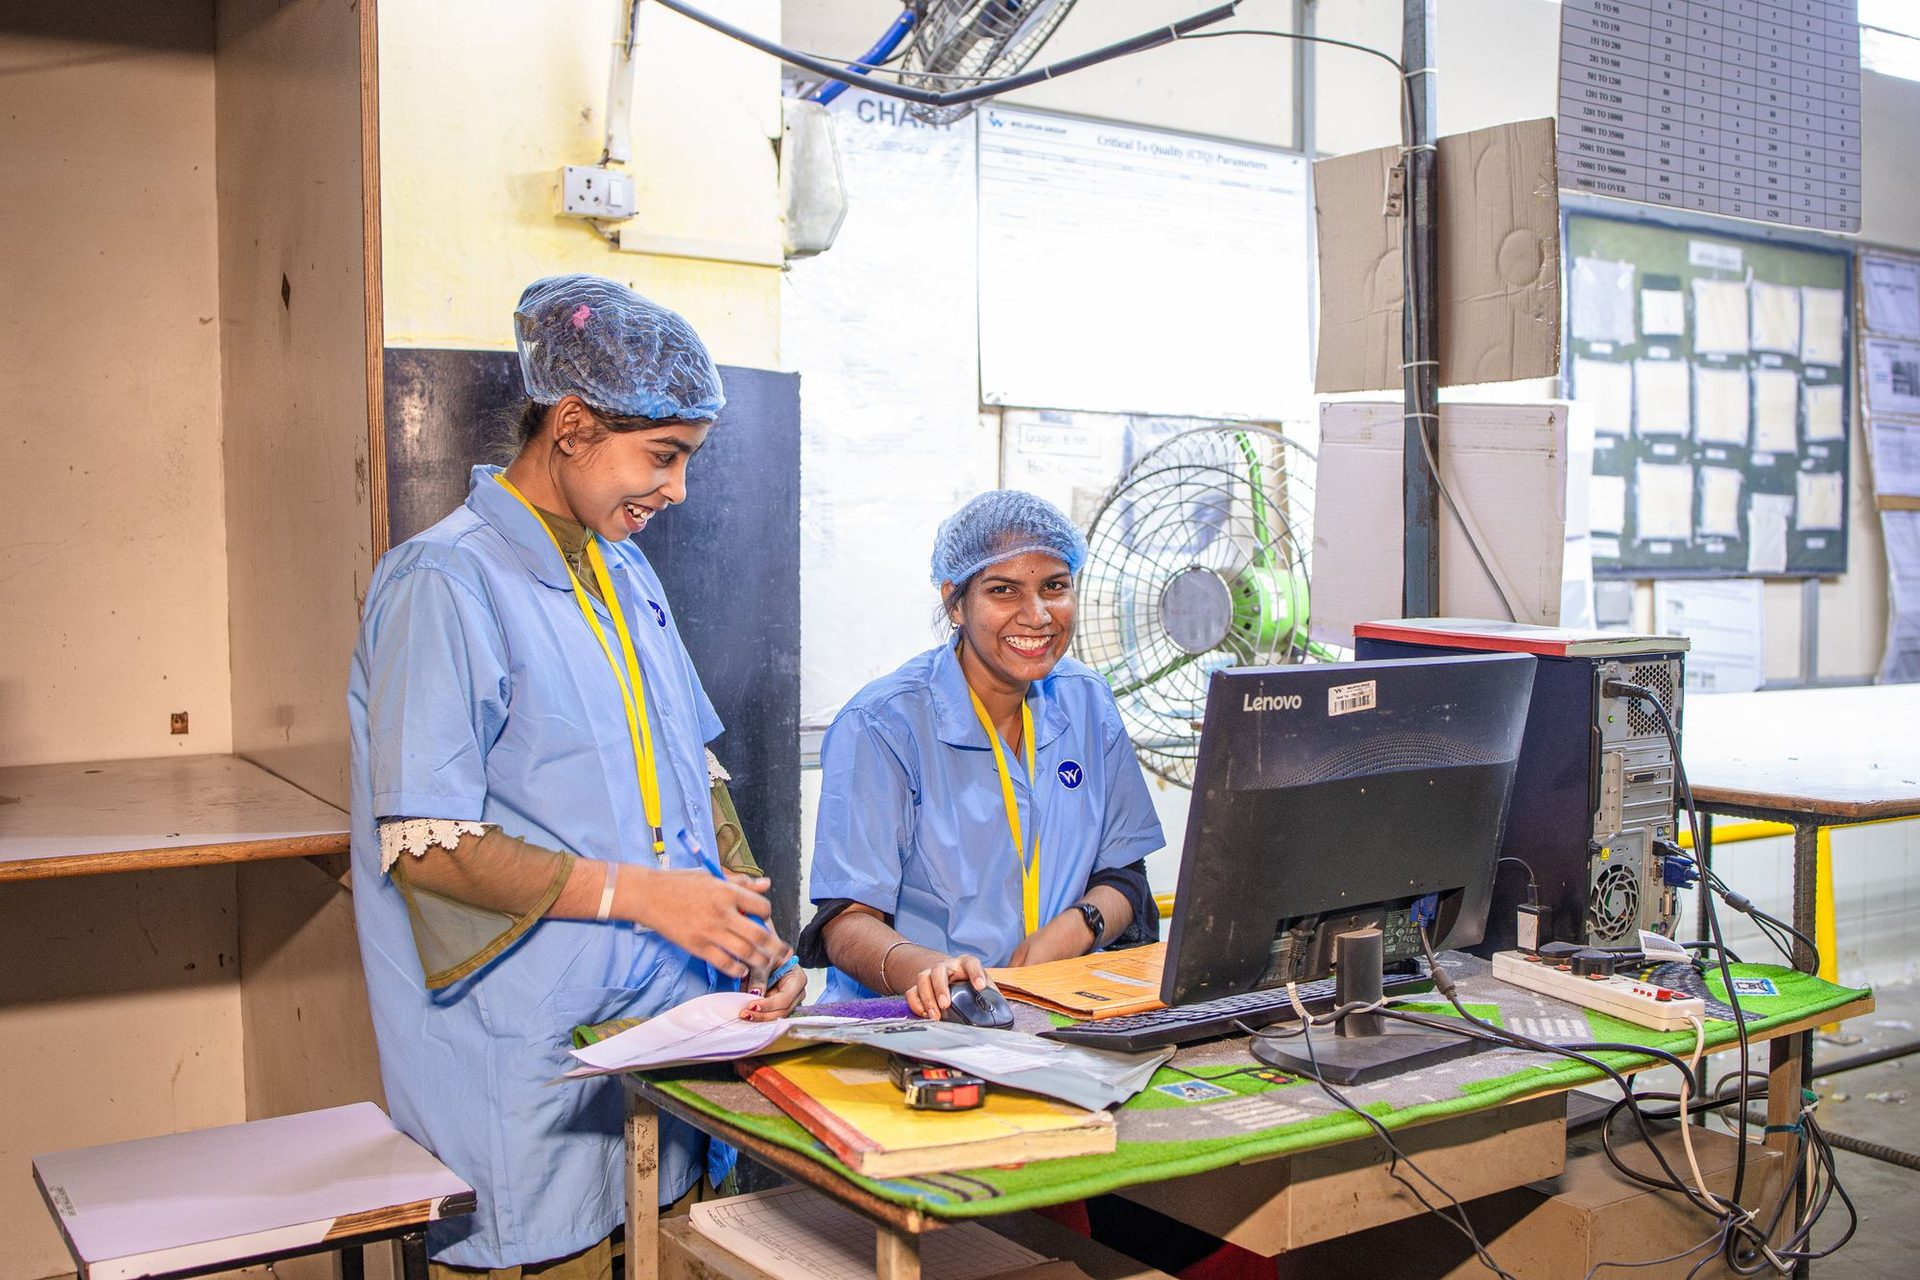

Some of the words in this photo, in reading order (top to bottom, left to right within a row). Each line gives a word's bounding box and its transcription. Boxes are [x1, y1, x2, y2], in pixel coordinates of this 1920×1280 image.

[1602, 3, 1612, 12] TO
[1600, 20, 1610, 29] TO
[1601, 38, 1610, 48] TO
[1600, 56, 1610, 66] TO
[1598, 74, 1608, 83] TO
[1599, 92, 1608, 101] TO
[858, 99, 950, 131] CHA
[1597, 110, 1606, 118] TO
[1598, 128, 1608, 136] TO
[1097, 134, 1134, 150] Critical
[1136, 141, 1148, 152] To
[1150, 143, 1184, 158] Quality
[1217, 154, 1267, 169] Parameters
[1596, 145, 1606, 154] TO
[1597, 163, 1607, 172] TO
[1597, 181, 1606, 190] TO
[1607, 182, 1626, 193] OVER
[1243, 693, 1302, 712] Lenovo
